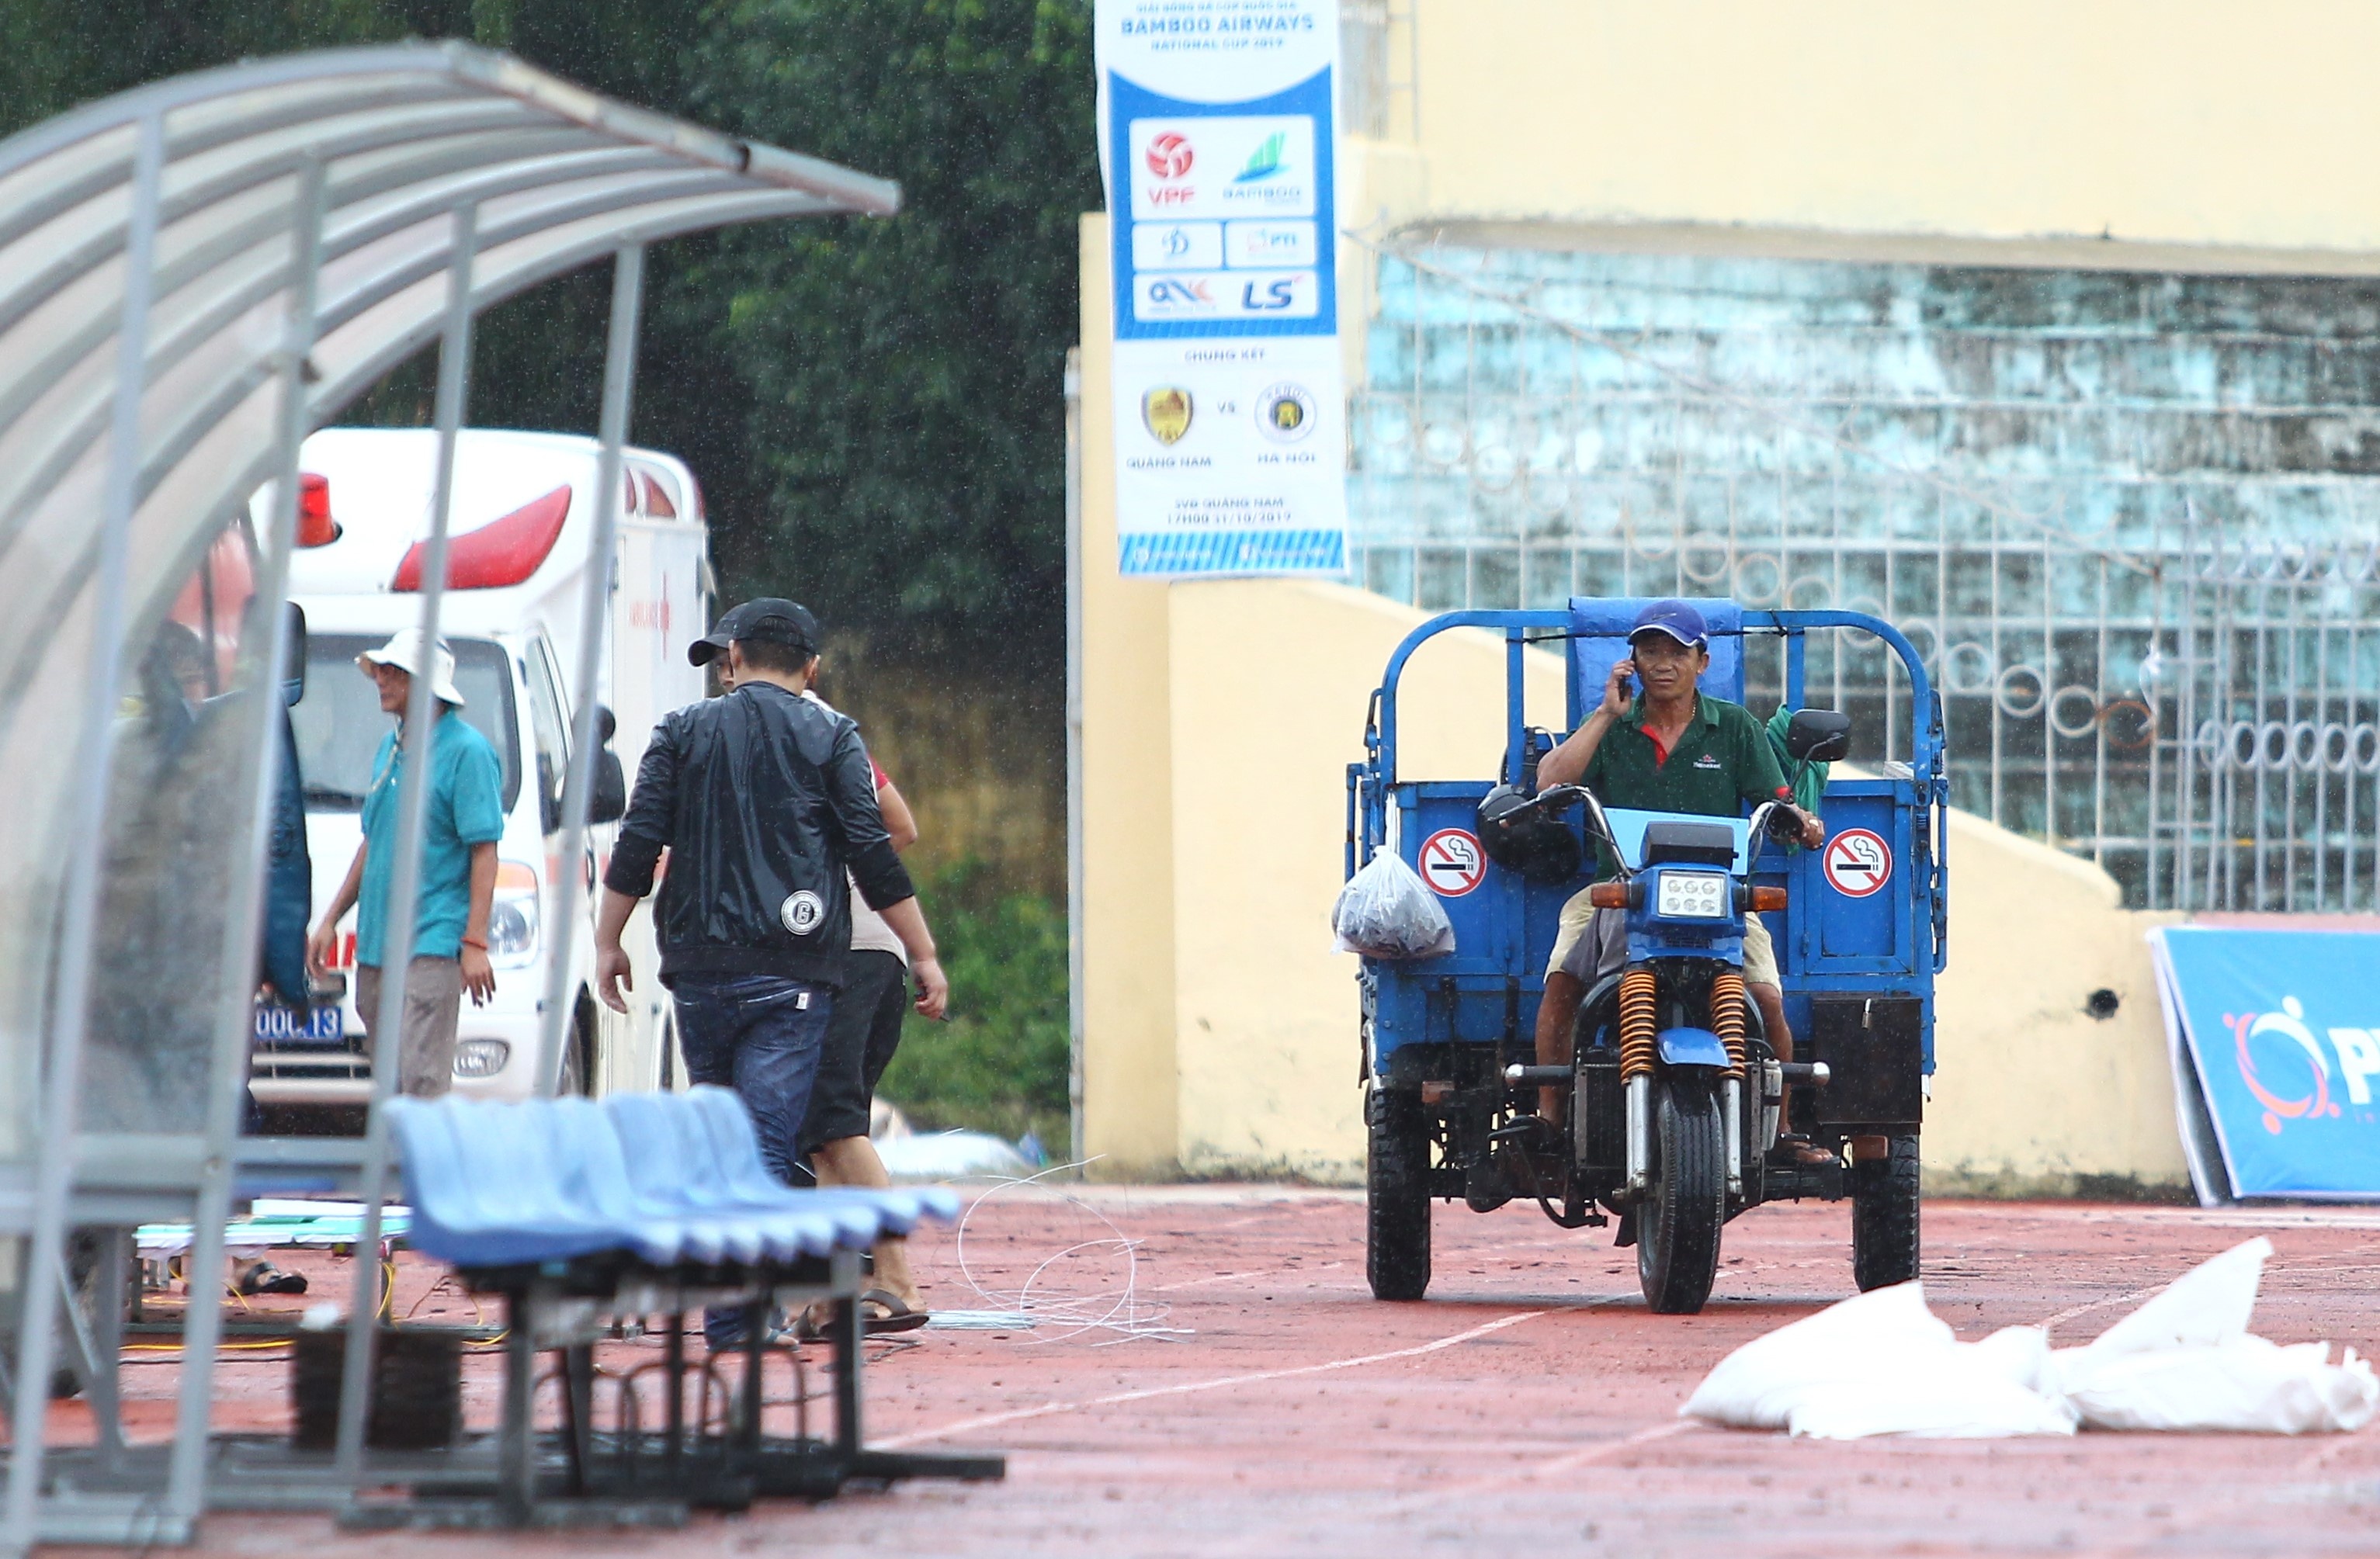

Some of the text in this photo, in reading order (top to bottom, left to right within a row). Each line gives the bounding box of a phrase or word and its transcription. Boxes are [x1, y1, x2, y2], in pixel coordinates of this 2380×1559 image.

[1121, 14, 1314, 34] BAMBOO AIRWAYS
[1150, 39, 1217, 50] NATIONAL
[1222, 38, 1248, 49] CUP
[1148, 185, 1195, 207] VPF
[1223, 185, 1300, 199] BAMBOO
[1185, 348, 1236, 362] CHUNG
[1217, 400, 1236, 414] VS
[1180, 456, 1212, 467] NAM
[1254, 497, 1284, 508] NAM
